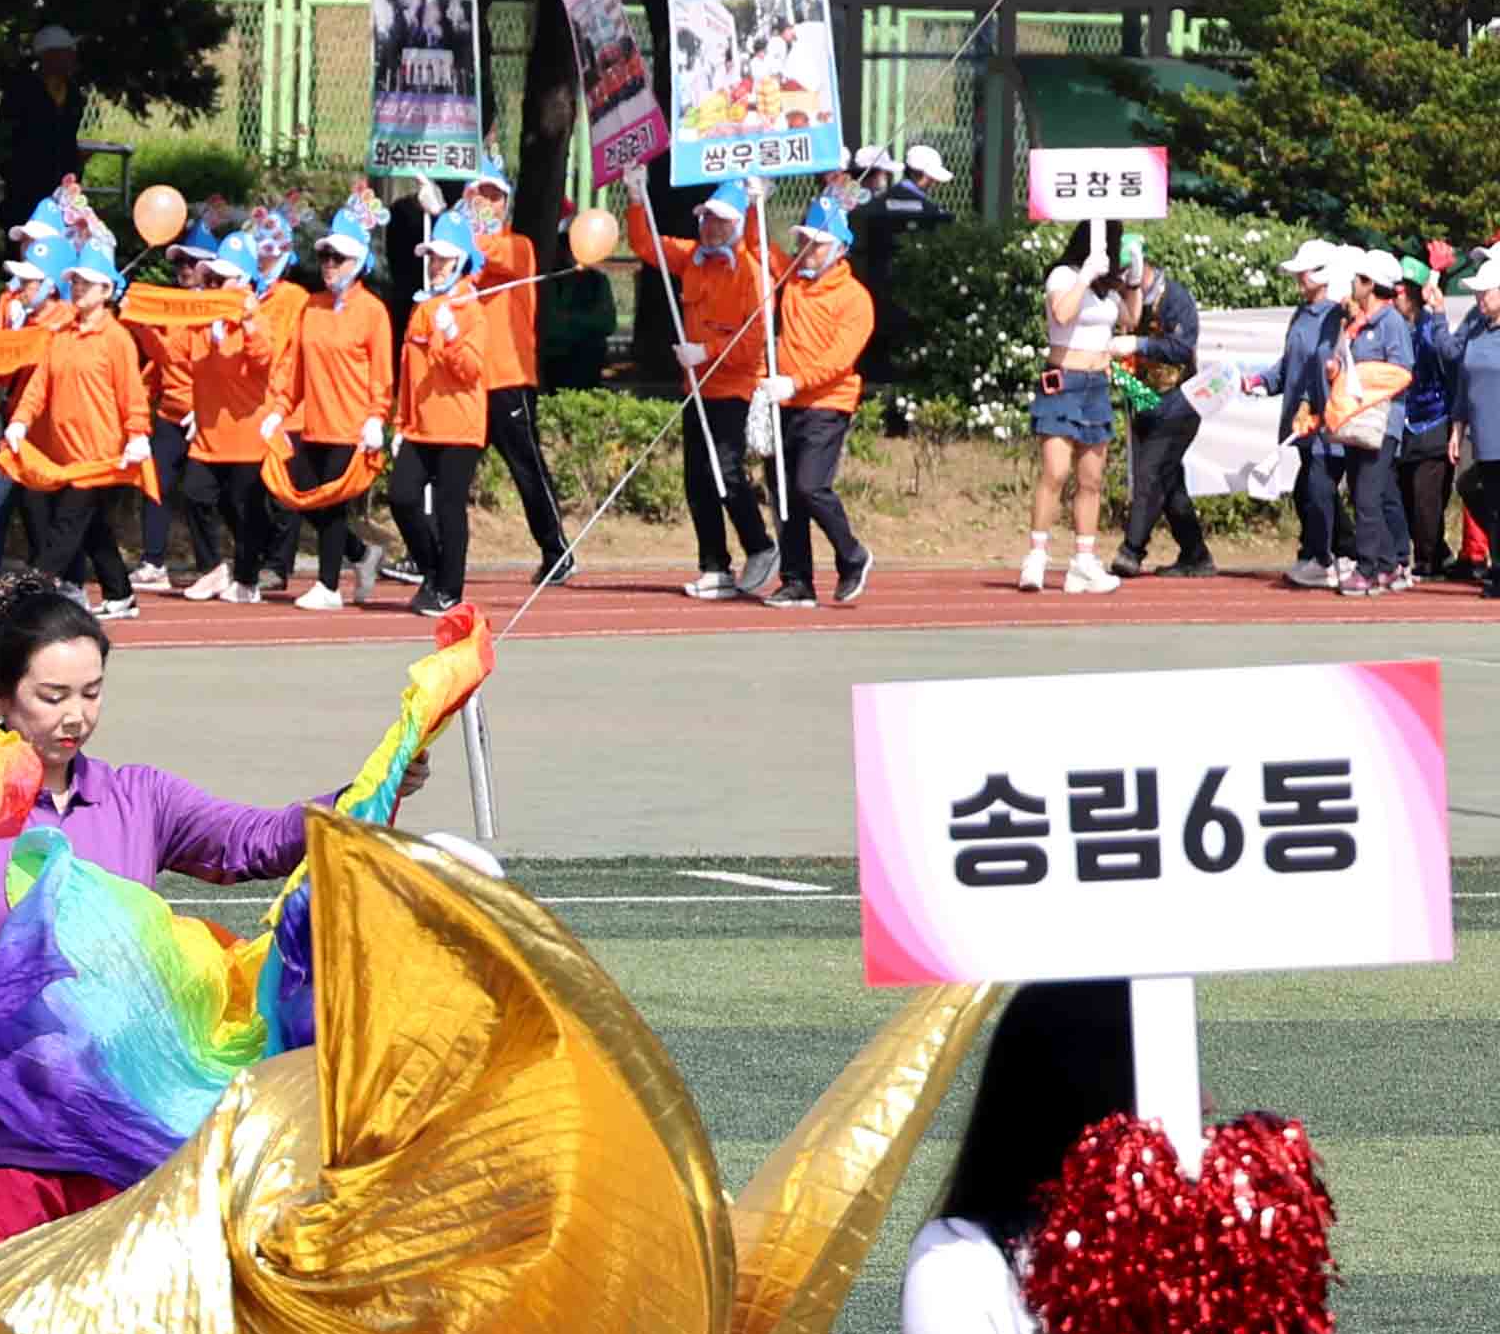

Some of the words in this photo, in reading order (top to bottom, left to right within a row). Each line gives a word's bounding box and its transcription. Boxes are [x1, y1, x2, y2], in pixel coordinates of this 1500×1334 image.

[375, 141, 438, 168] 화수부두
[443, 144, 477, 171] 축제
[948, 757, 1360, 888] 송림6동
